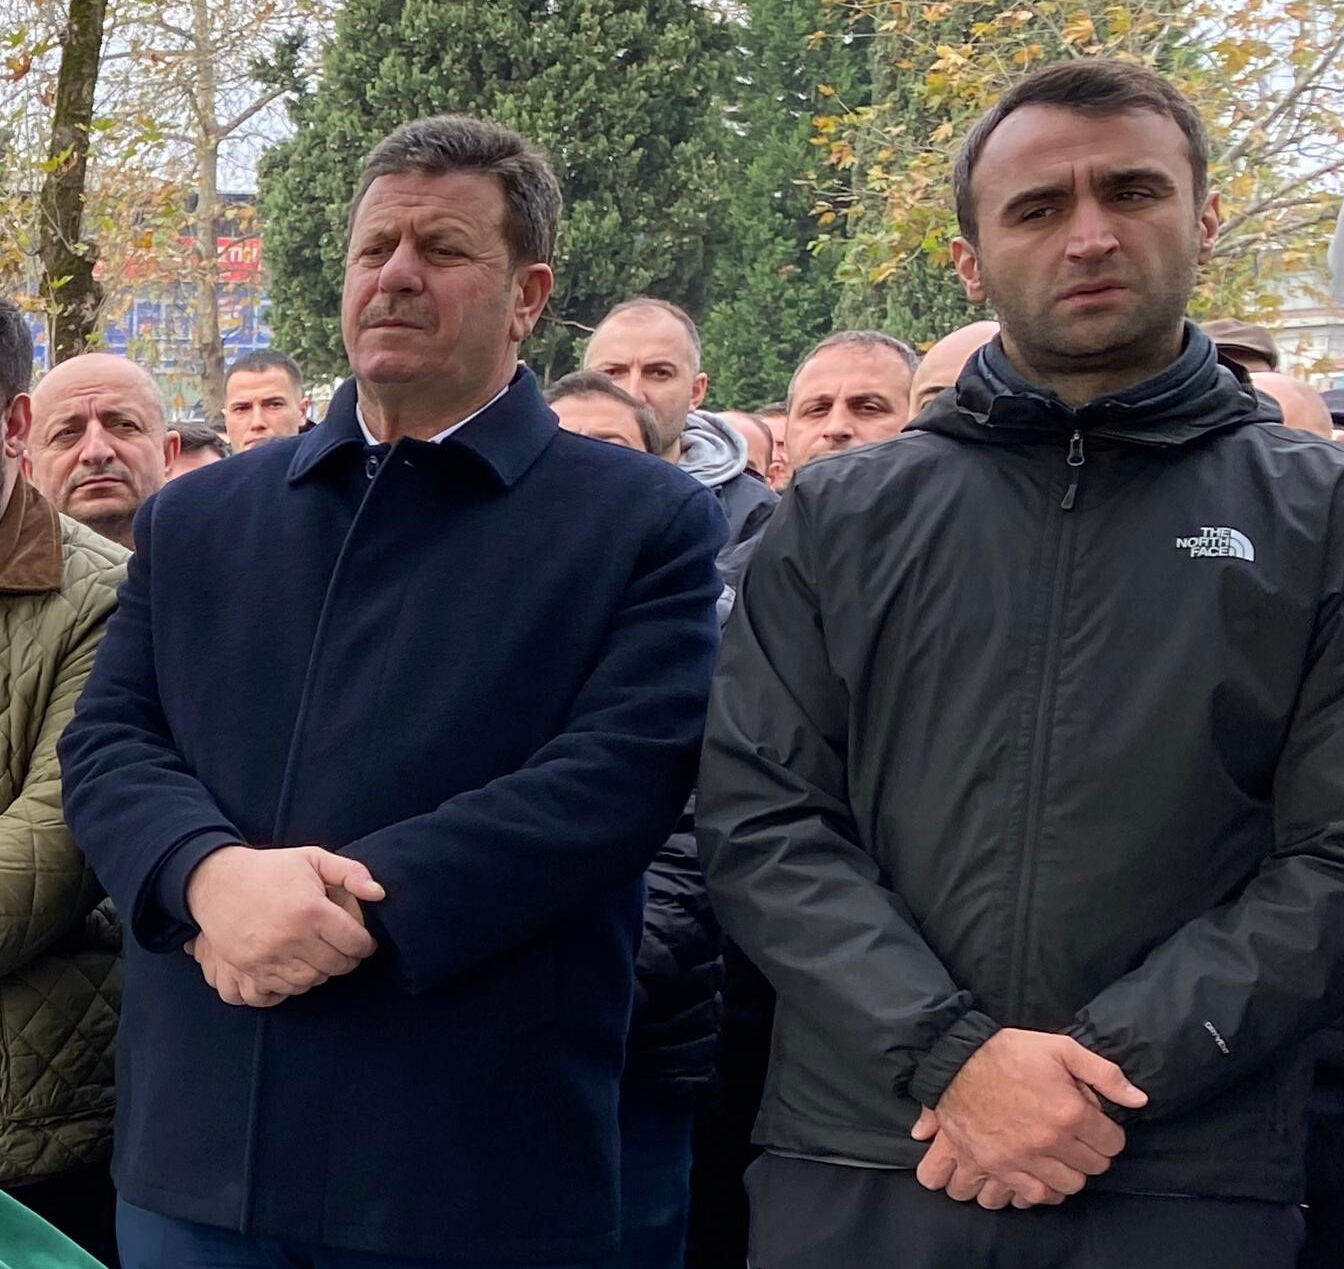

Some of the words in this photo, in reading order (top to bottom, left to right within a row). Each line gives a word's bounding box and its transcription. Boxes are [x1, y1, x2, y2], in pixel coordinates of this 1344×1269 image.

[1199, 526, 1231, 538] THE
[1175, 536, 1230, 549] NORTH
[1189, 546, 1229, 558] FACE
